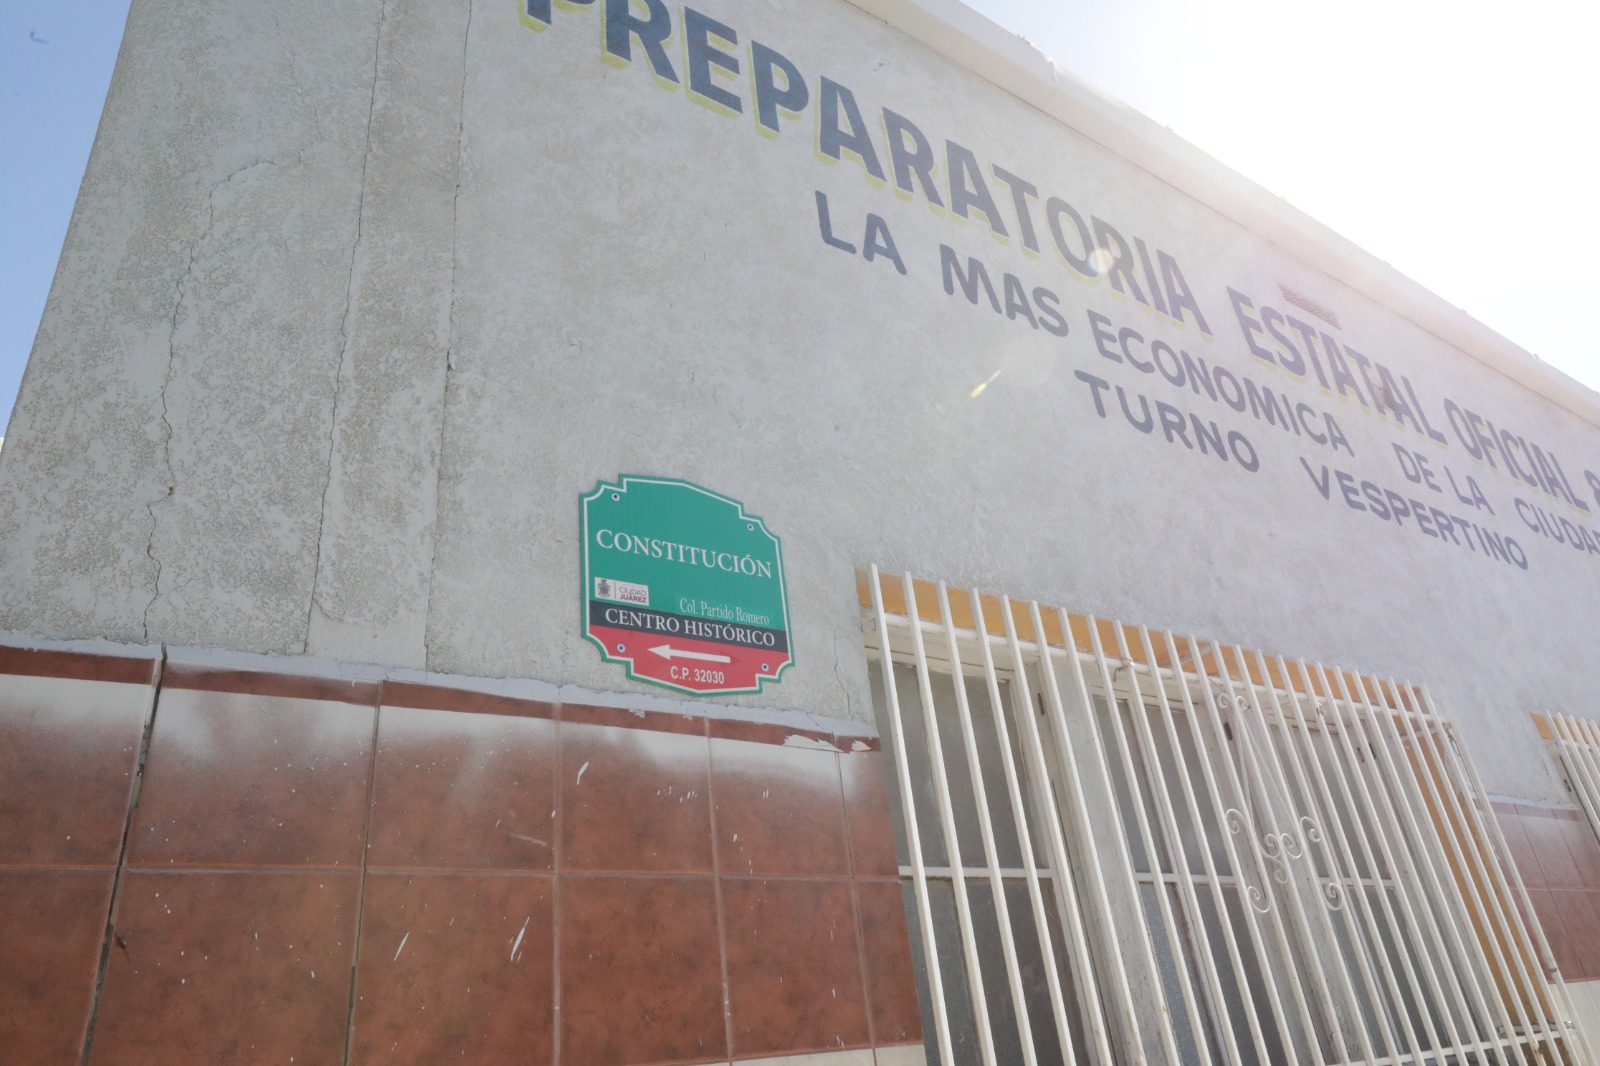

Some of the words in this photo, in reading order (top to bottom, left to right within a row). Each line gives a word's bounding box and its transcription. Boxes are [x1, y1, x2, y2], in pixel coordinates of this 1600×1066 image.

[519, 0, 1214, 338] REPARATORIA
[1226, 285, 1448, 449] ESTATAL
[1443, 397, 1591, 514] OFICIAL
[814, 189, 907, 276] LA
[938, 242, 1070, 338] MAS
[1086, 308, 1356, 457] ECONOMICA
[1391, 441, 1443, 493] DE
[1449, 465, 1496, 516] LA
[1073, 368, 1260, 473] TURNO
[1299, 455, 1529, 572] VESPERTINO
[596, 529, 772, 579] CONSTITUCIÓN
[619, 586, 647, 597] CIUDAD
[679, 597, 699, 614] Col.
[701, 601, 734, 621] Partido
[735, 606, 770, 626] Romero
[605, 608, 680, 633] CENTRO
[684, 619, 775, 647] HISTÓRICO
[670, 666, 692, 681] C.P.
[694, 668, 725, 685] 32030
